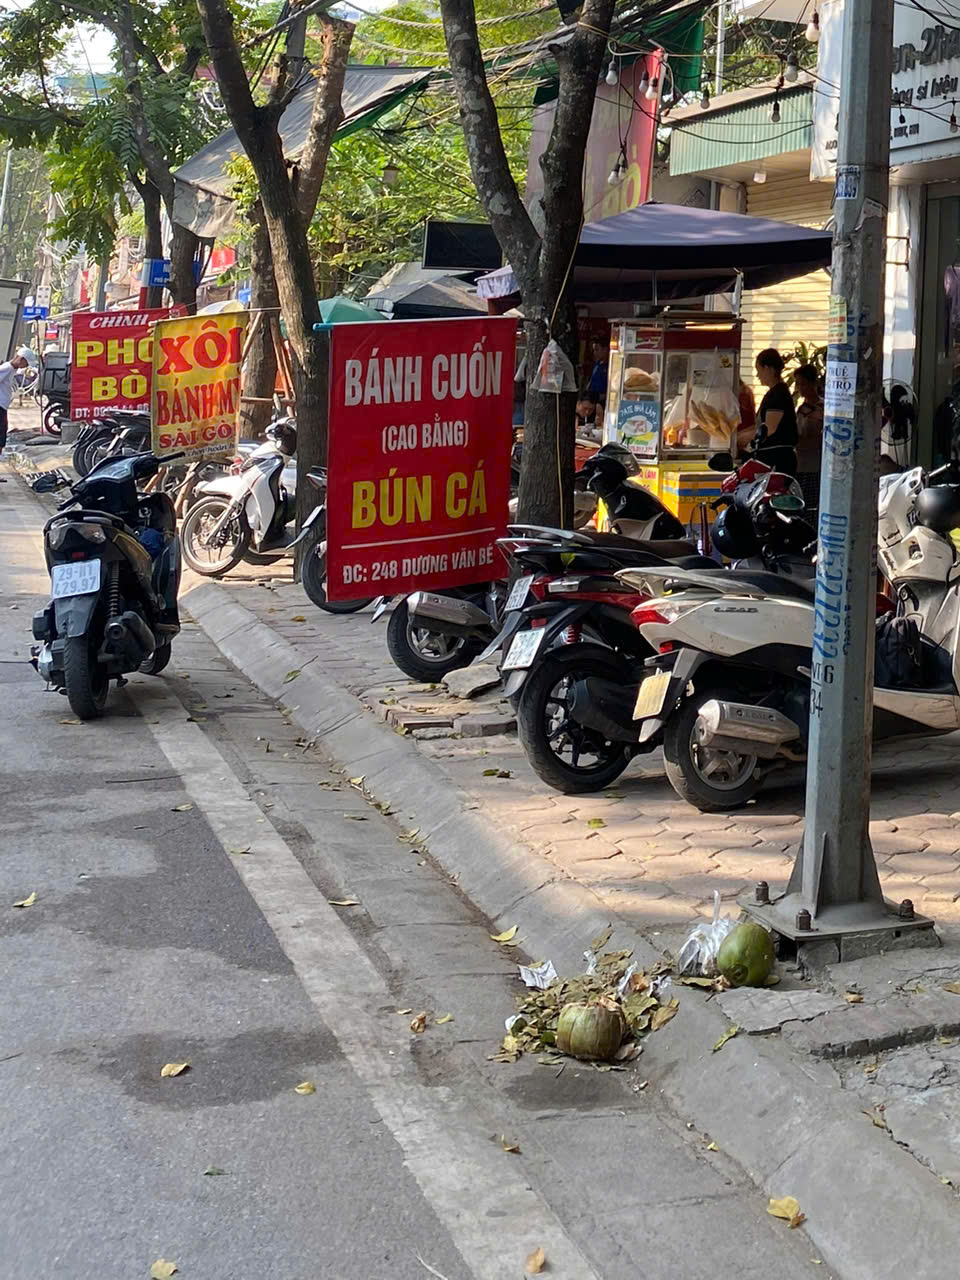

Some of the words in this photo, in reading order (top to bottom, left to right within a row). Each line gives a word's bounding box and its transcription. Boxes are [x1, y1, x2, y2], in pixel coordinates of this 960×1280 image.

[156, 319, 243, 376] XÔI
[91, 368, 148, 401] BÒ
[344, 347, 423, 407] BÁNH
[431, 335, 503, 401] CUỐN
[156, 378, 215, 426] BÁNH
[159, 427, 199, 449] SÀI
[202, 420, 237, 441] GÒ
[382, 423, 418, 454] (CAO
[351, 466, 433, 529] BÚN
[445, 459, 488, 520] CÁ
[343, 564, 368, 585] ĐC:
[371, 559, 398, 582] 248
[402, 552, 449, 578] DƯƠNG
[451, 547, 477, 570] VĂN
[478, 542, 494, 566] BÉ
[824, 664, 834, 684] 6
